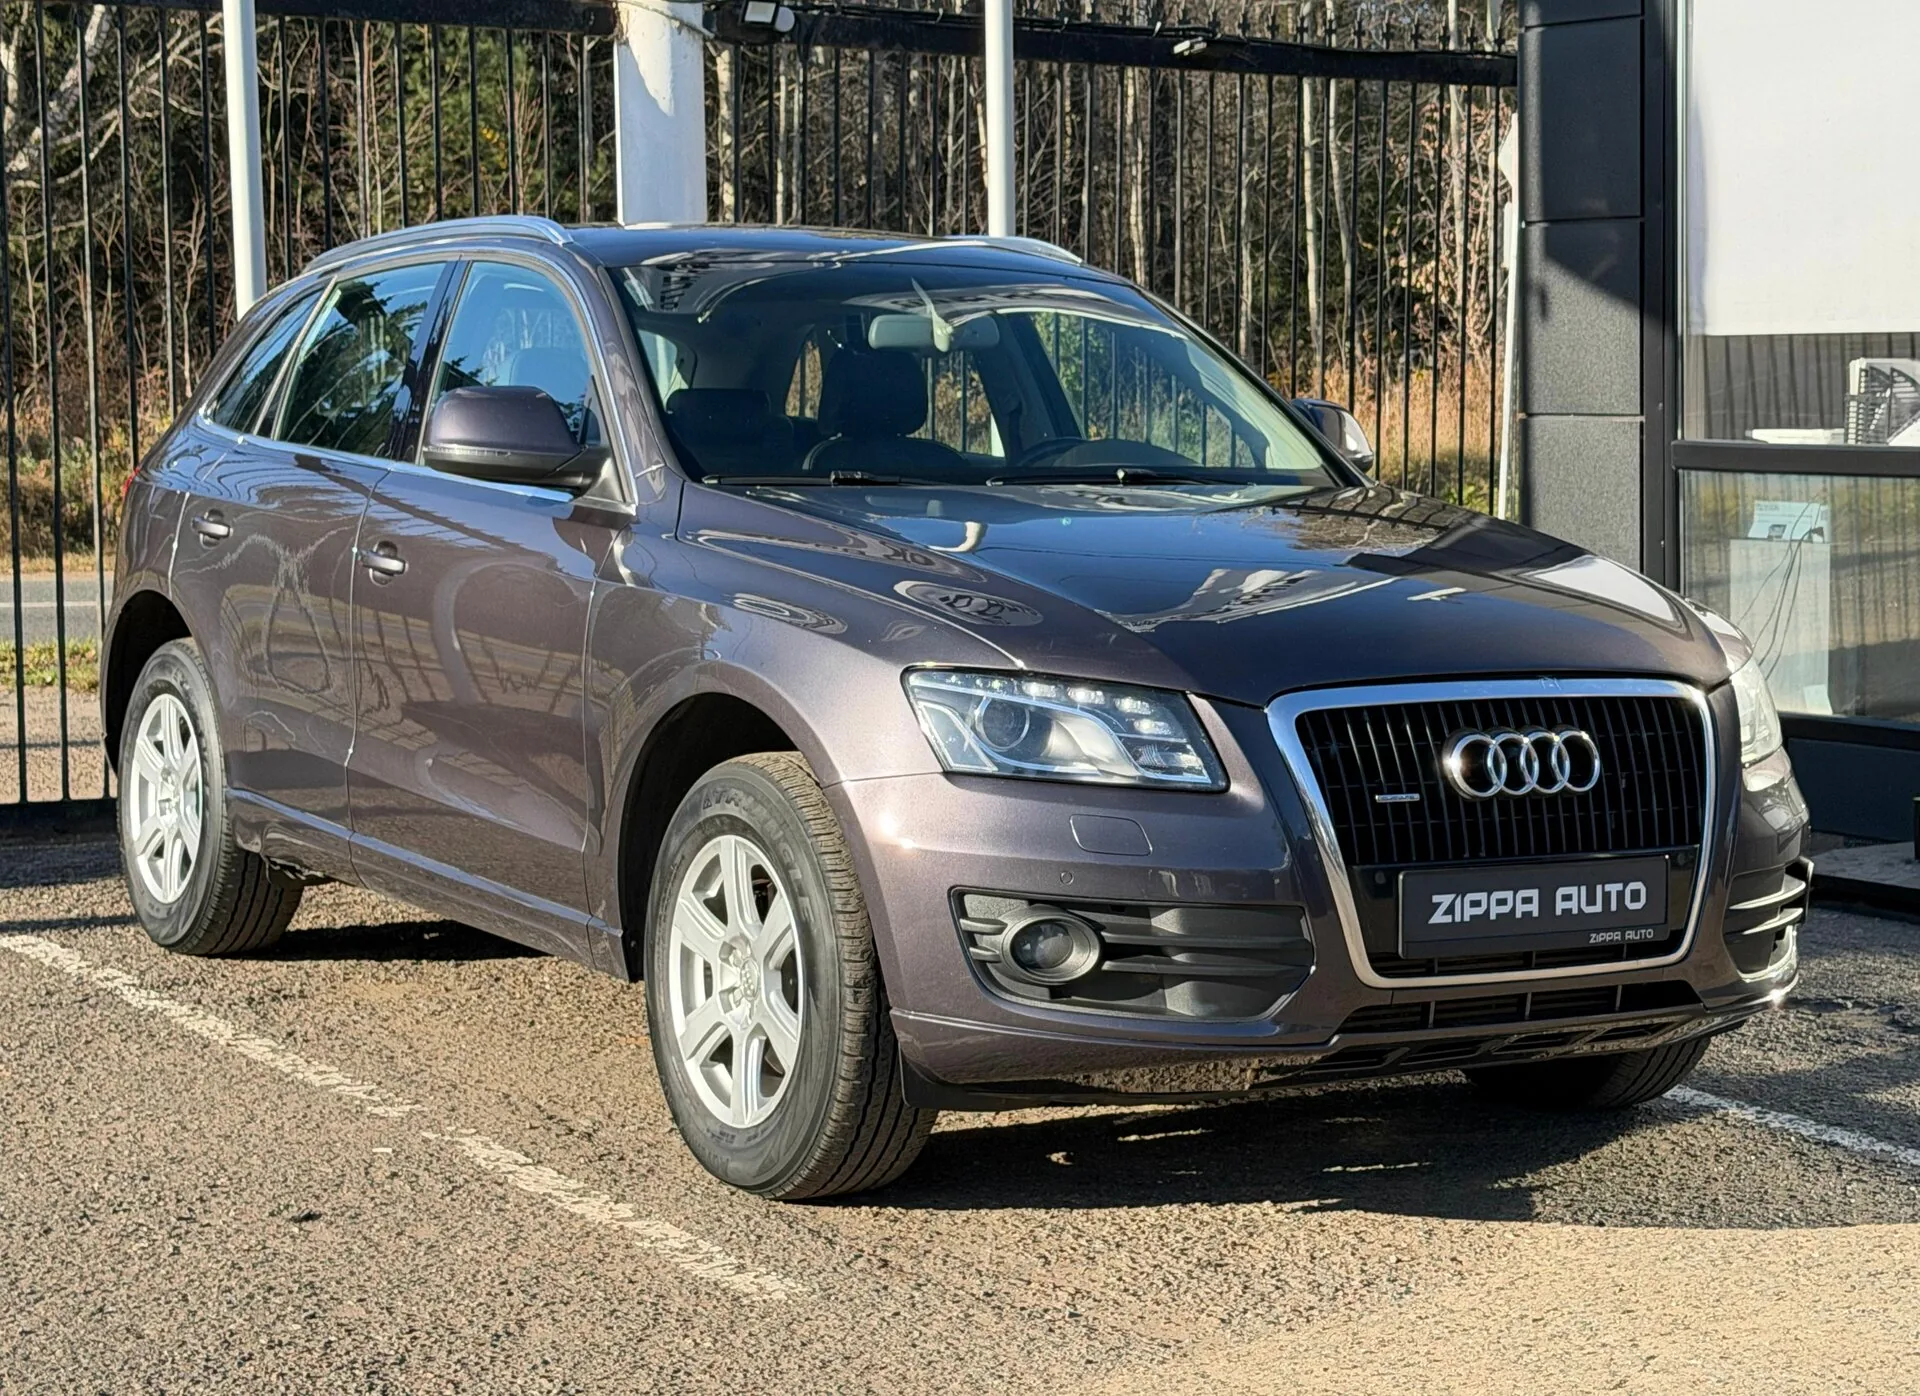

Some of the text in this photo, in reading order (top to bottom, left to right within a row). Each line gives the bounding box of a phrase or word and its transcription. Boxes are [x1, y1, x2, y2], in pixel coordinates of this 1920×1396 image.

[1428, 881, 1647, 924] ZIPPA AUTO
[1589, 928, 1654, 944] ZIPPA AUTO
